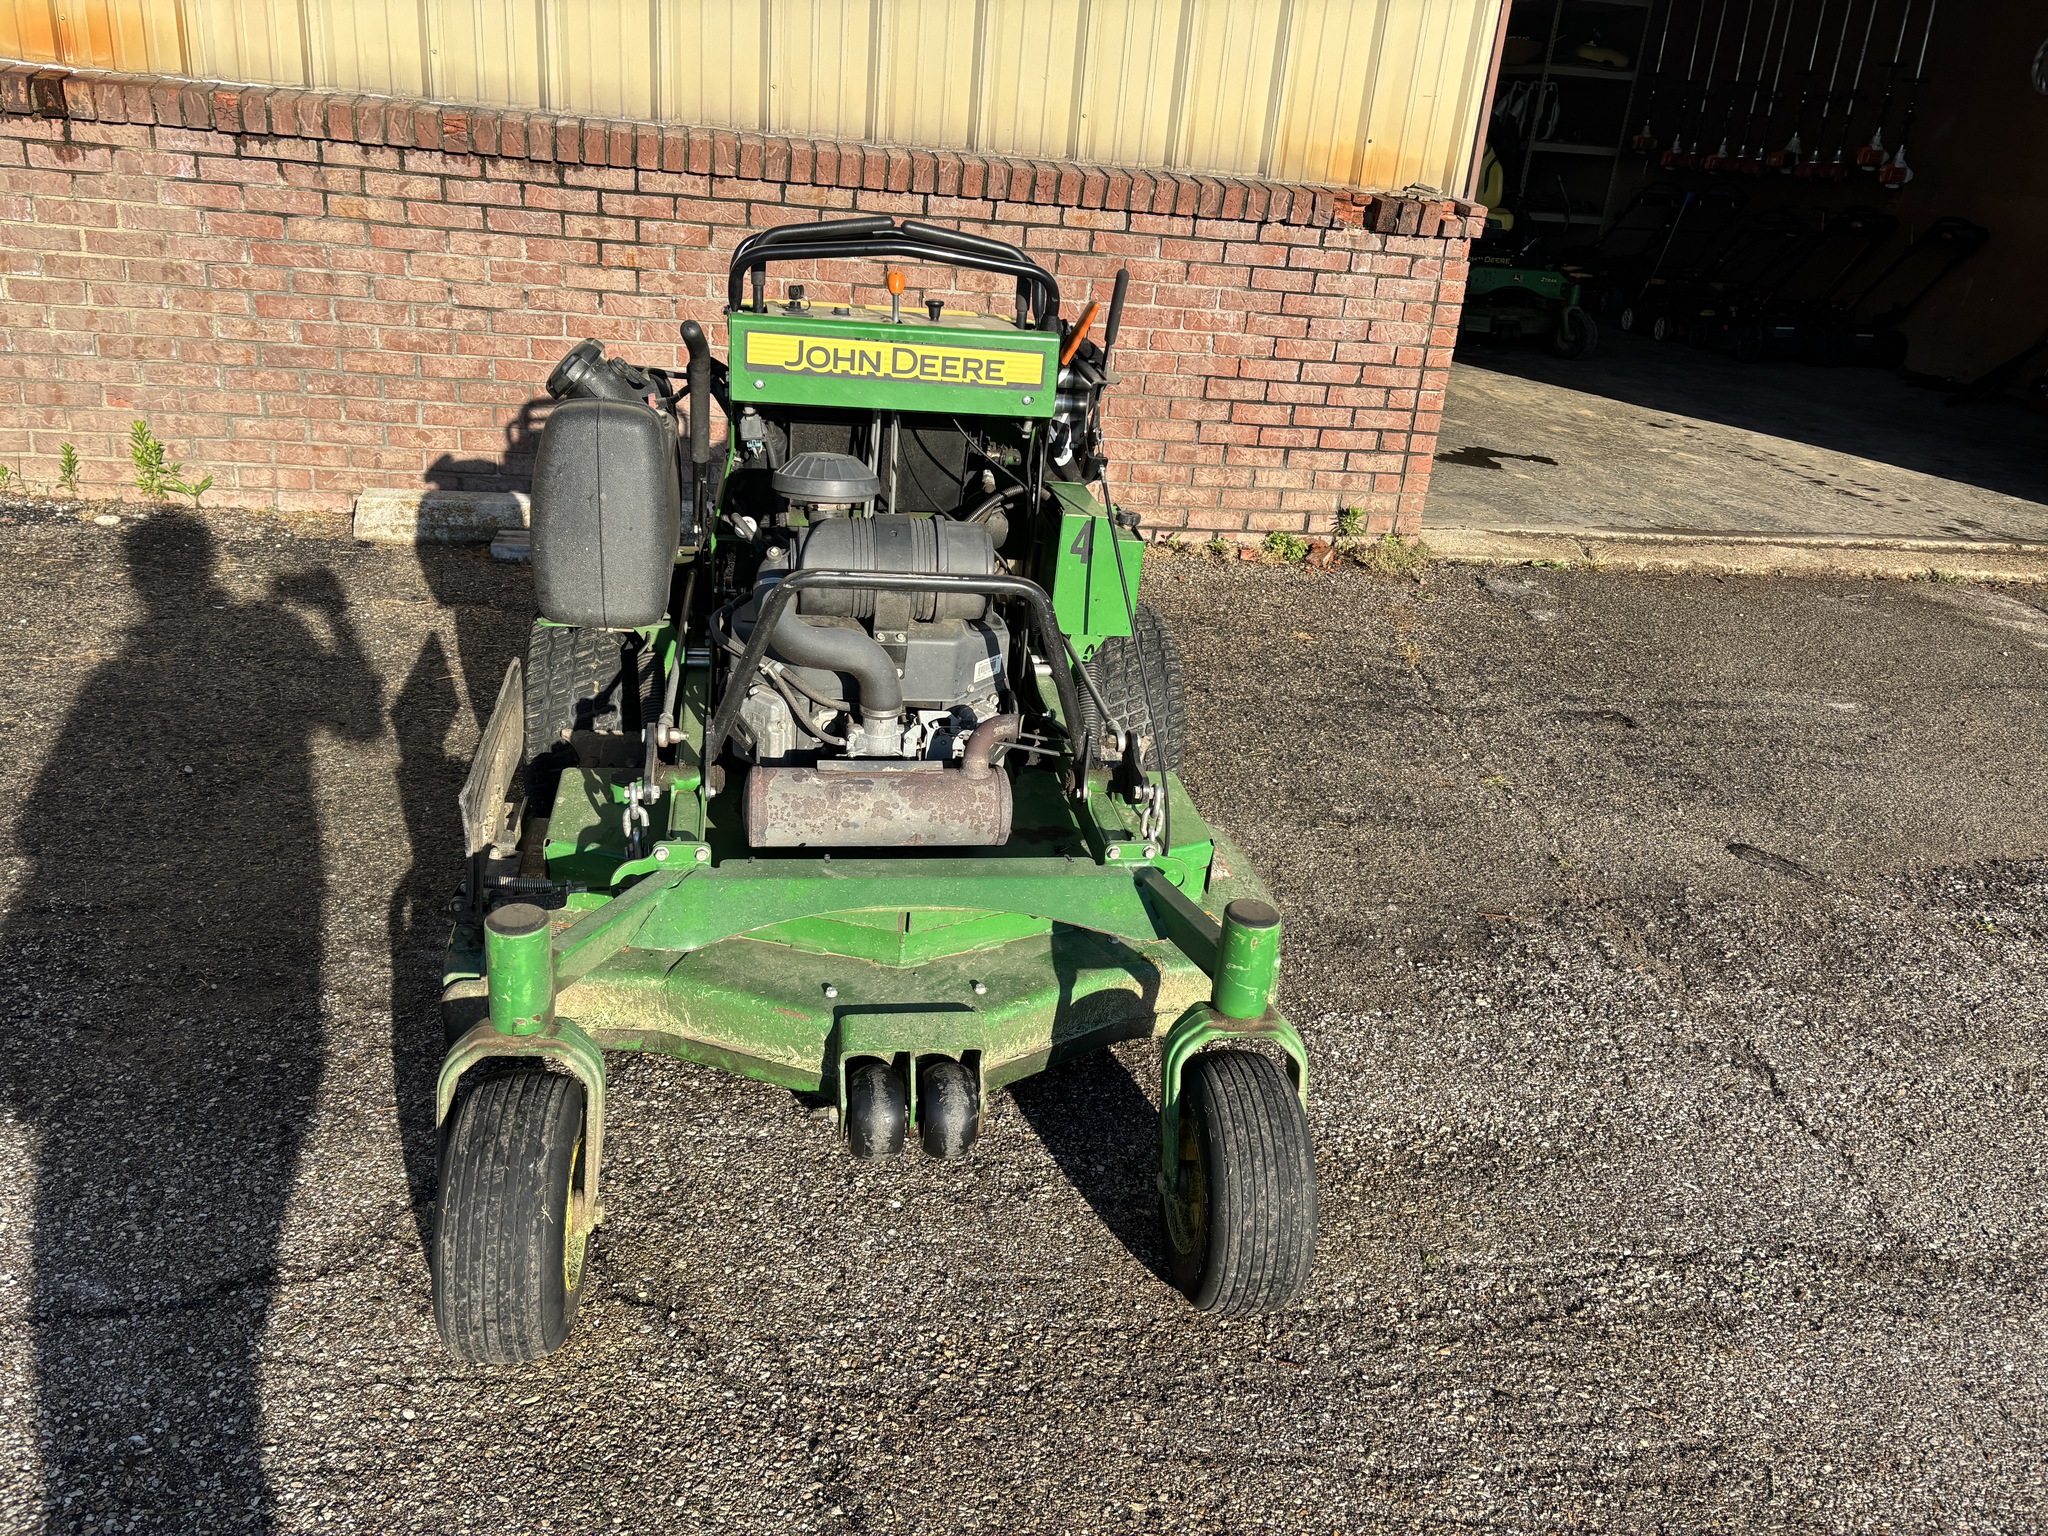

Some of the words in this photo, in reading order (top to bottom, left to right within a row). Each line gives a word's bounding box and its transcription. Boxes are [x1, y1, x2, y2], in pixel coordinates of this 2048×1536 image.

[1484, 256, 1510, 264] DEERE
[785, 339, 881, 372] JOHN
[892, 347, 1005, 381] DEERE
[1070, 520, 1092, 564] 4
